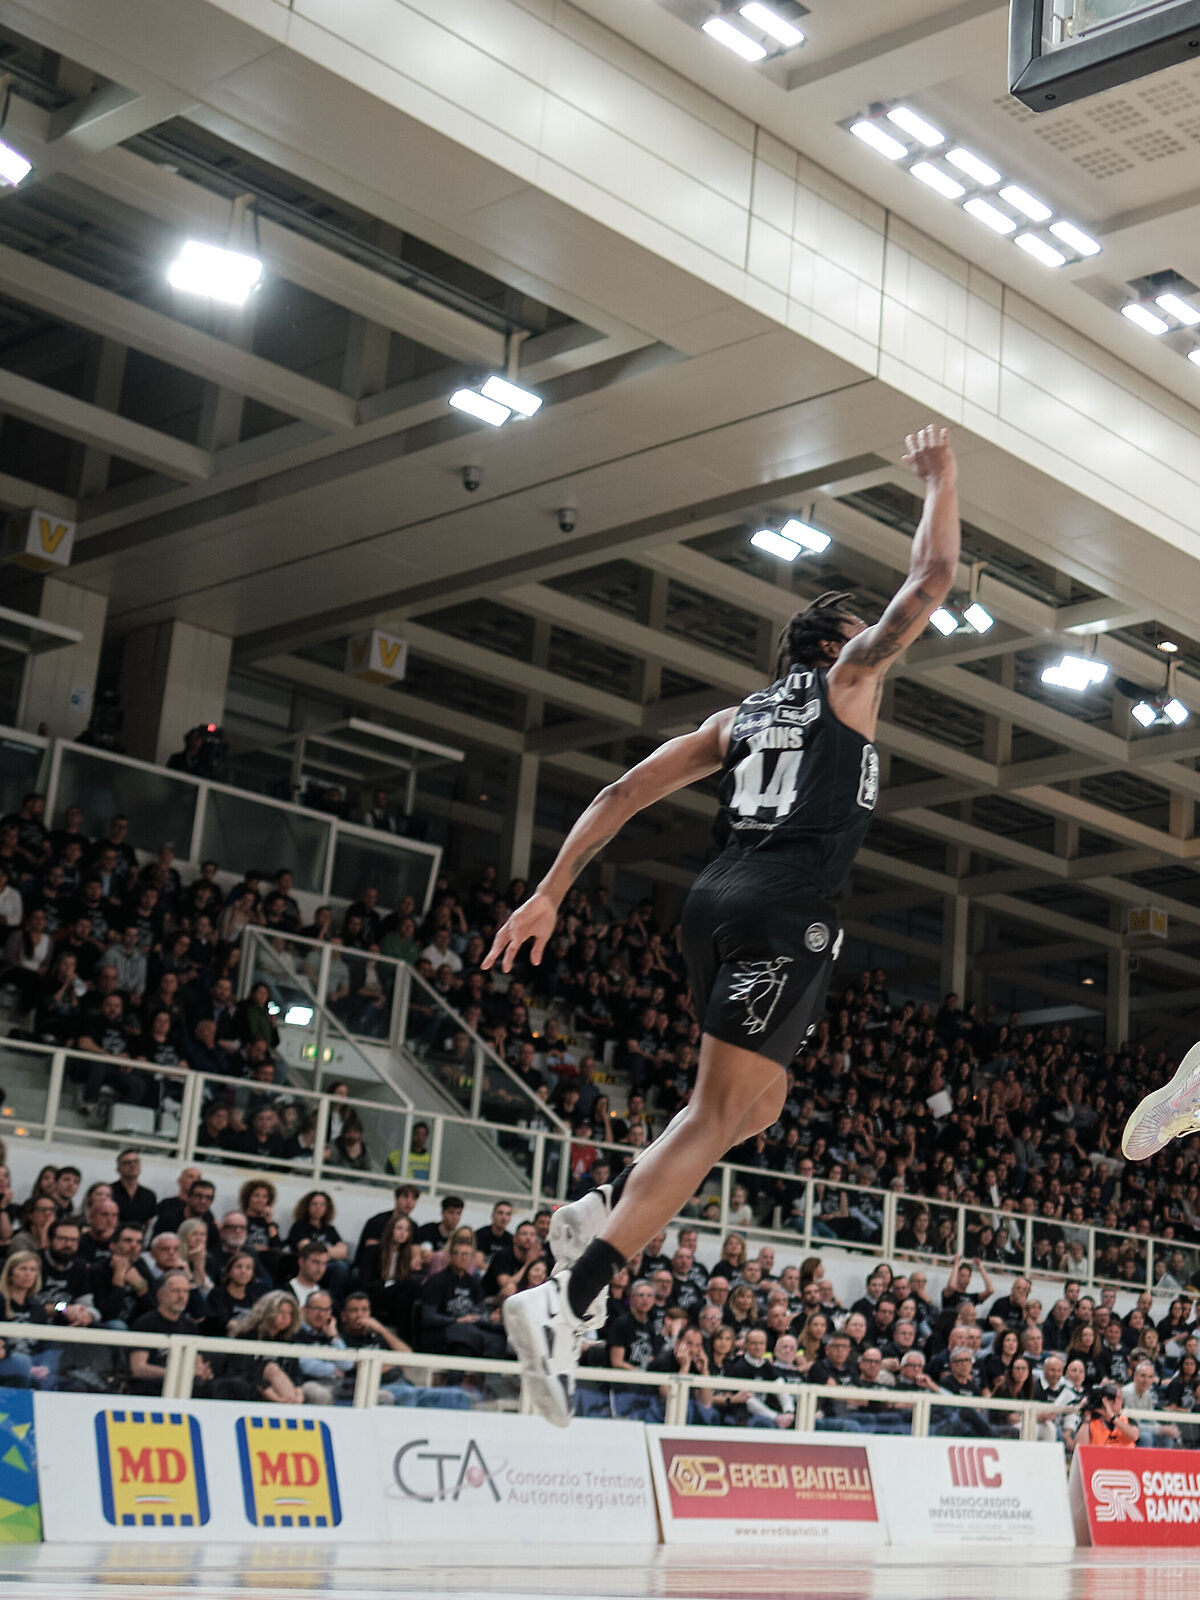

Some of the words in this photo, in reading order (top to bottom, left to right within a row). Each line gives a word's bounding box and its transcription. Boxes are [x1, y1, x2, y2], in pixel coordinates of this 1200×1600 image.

[40, 517, 68, 553] V
[378, 637, 401, 668] V
[117, 1446, 187, 1484] MD
[256, 1451, 320, 1487] MD
[393, 1439, 501, 1503] CTA
[729, 1463, 788, 1489] EREDI
[791, 1465, 872, 1491] BAITELLI
[506, 1469, 581, 1487] Consorzio
[584, 1471, 645, 1490] Trentino
[507, 1488, 647, 1509] Autonoleggiatori
[940, 1496, 1020, 1513] MEDIOCREDITO
[928, 1508, 1033, 1520] INVESTITIONSBANK
[735, 1525, 829, 1537] www.eredibaitelli.it
